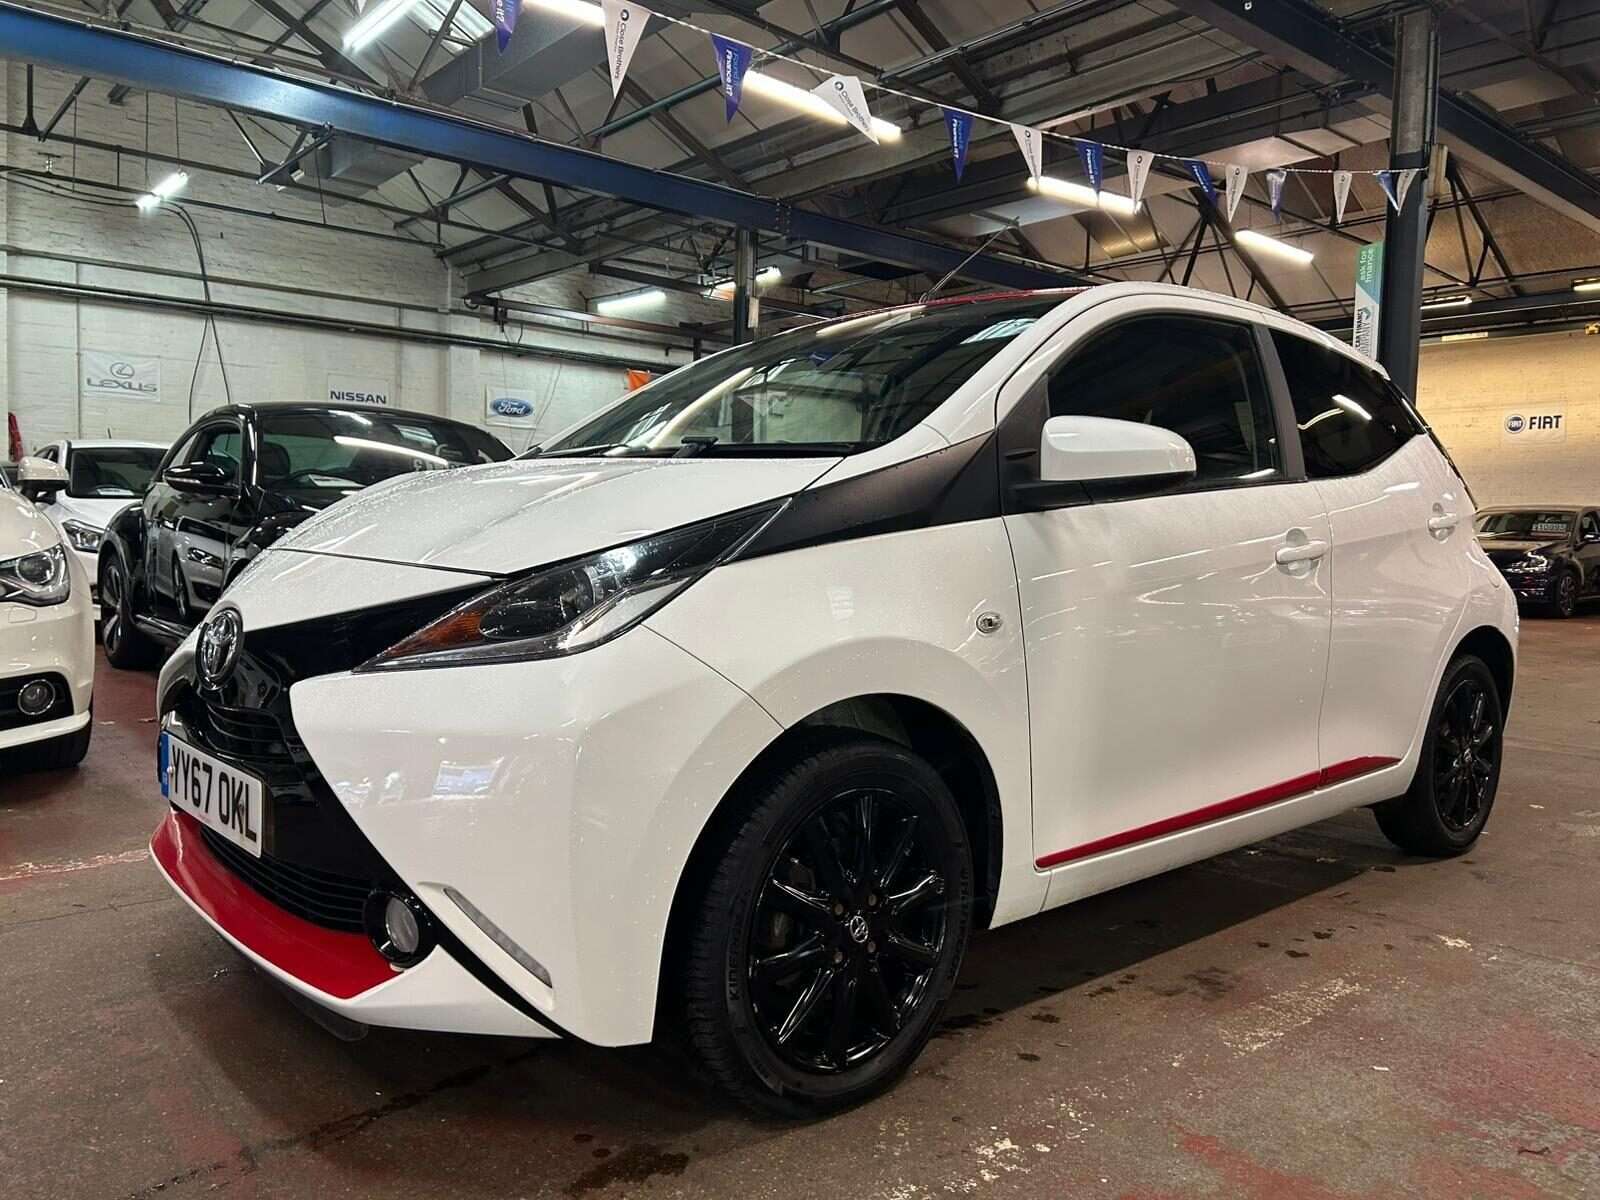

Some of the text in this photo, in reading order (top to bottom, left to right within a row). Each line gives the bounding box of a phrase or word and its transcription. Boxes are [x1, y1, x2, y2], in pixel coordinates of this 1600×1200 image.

[619, 22, 627, 46] Close
[614, 46, 624, 79] Brothers
[725, 49, 733, 97] Finance it?
[1359, 264, 1367, 281] ask
[1365, 248, 1374, 283] finance
[87, 378, 157, 392] LEXUS
[330, 390, 387, 404] NISSAN
[498, 400, 526, 414] Ford
[1529, 415, 1562, 430] FIAT
[172, 744, 257, 843] YY67 OKL
